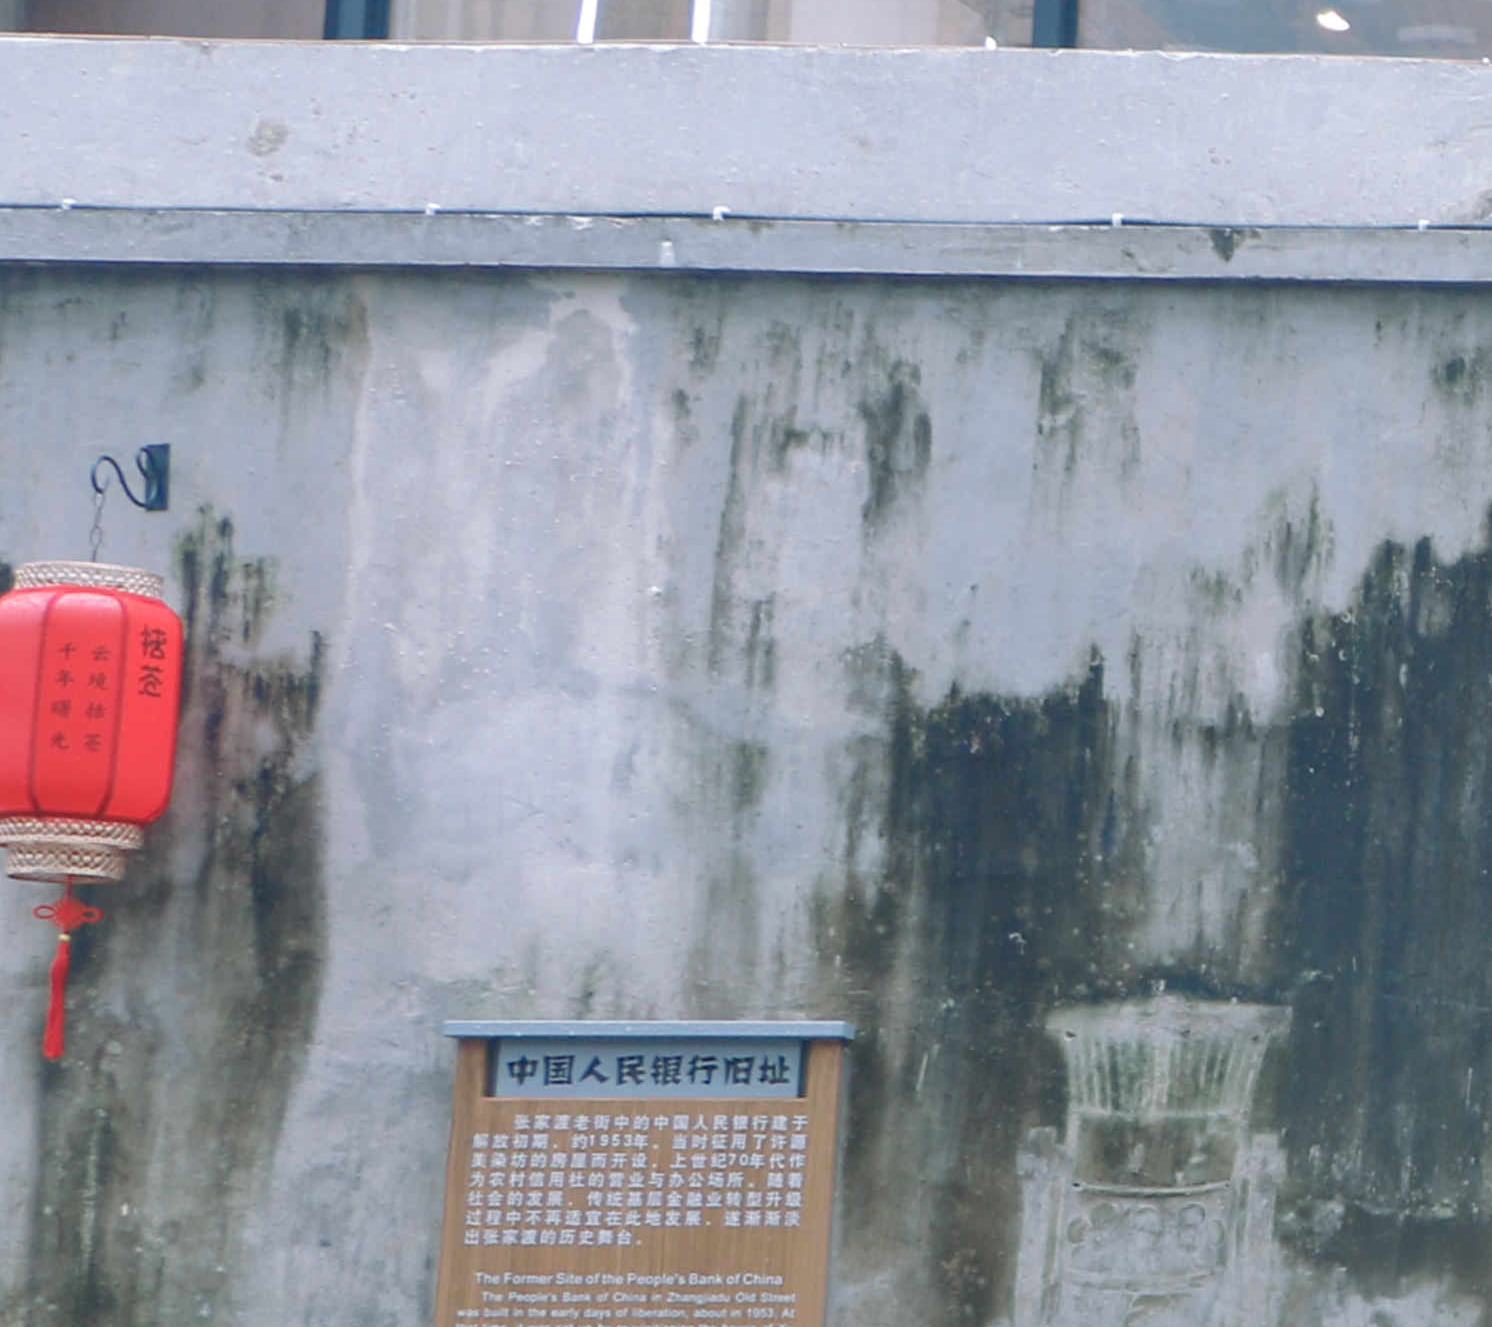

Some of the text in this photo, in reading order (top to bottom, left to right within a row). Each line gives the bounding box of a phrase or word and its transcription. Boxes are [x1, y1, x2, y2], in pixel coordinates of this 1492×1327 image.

[506, 1054, 791, 1086] 中国人民银行旧址
[514, 1114, 809, 1131] 张家渡老街中的中国人民银行建于
[475, 1273, 783, 1286] The Former Site of the People's Bank of China
[482, 1292, 503, 1302] The
[508, 1292, 557, 1304] People's
[562, 1292, 591, 1302] Bank
[596, 1292, 609, 1302] of
[613, 1292, 647, 1302] China
[651, 1292, 662, 1302] in
[735, 1292, 756, 1302] Old
[761, 1292, 796, 1302] Street
[484, 1308, 509, 1317] built
[513, 1308, 524, 1317] in
[528, 1308, 547, 1317] the
[551, 1308, 580, 1319] early
[584, 1308, 611, 1319] days
[616, 1308, 628, 1317] of
[694, 1308, 726, 1317] about
[731, 1308, 742, 1317] in
[781, 1308, 795, 1317] At
